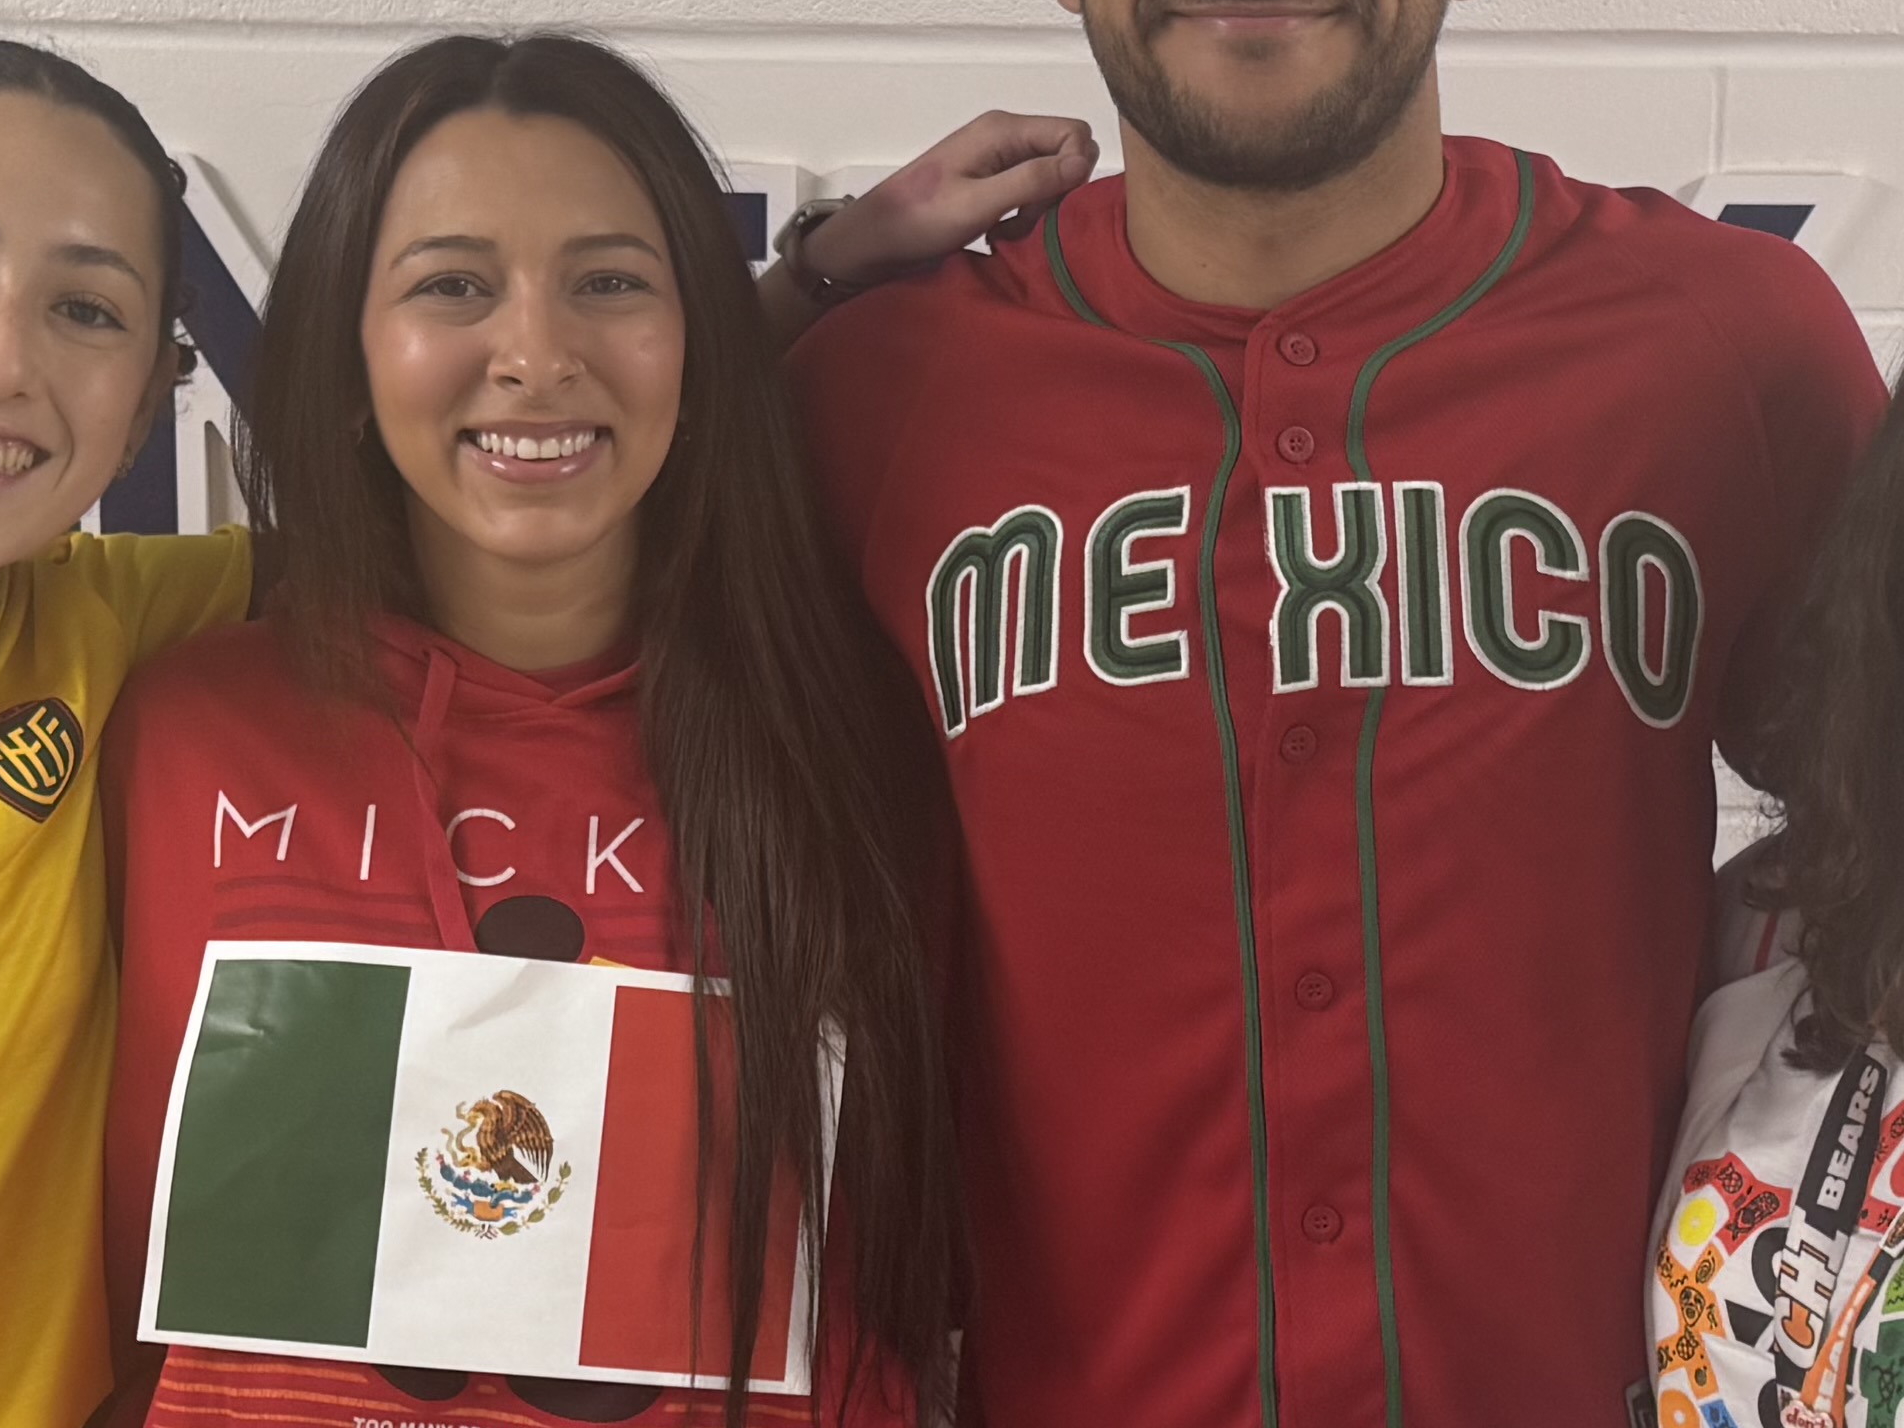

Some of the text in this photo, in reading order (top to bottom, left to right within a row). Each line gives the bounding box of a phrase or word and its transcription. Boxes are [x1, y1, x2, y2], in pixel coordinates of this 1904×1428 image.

[925, 479, 1704, 740] MEXICO
[212, 789, 646, 895] MICK
[1816, 1065, 1881, 1212] BEARS
